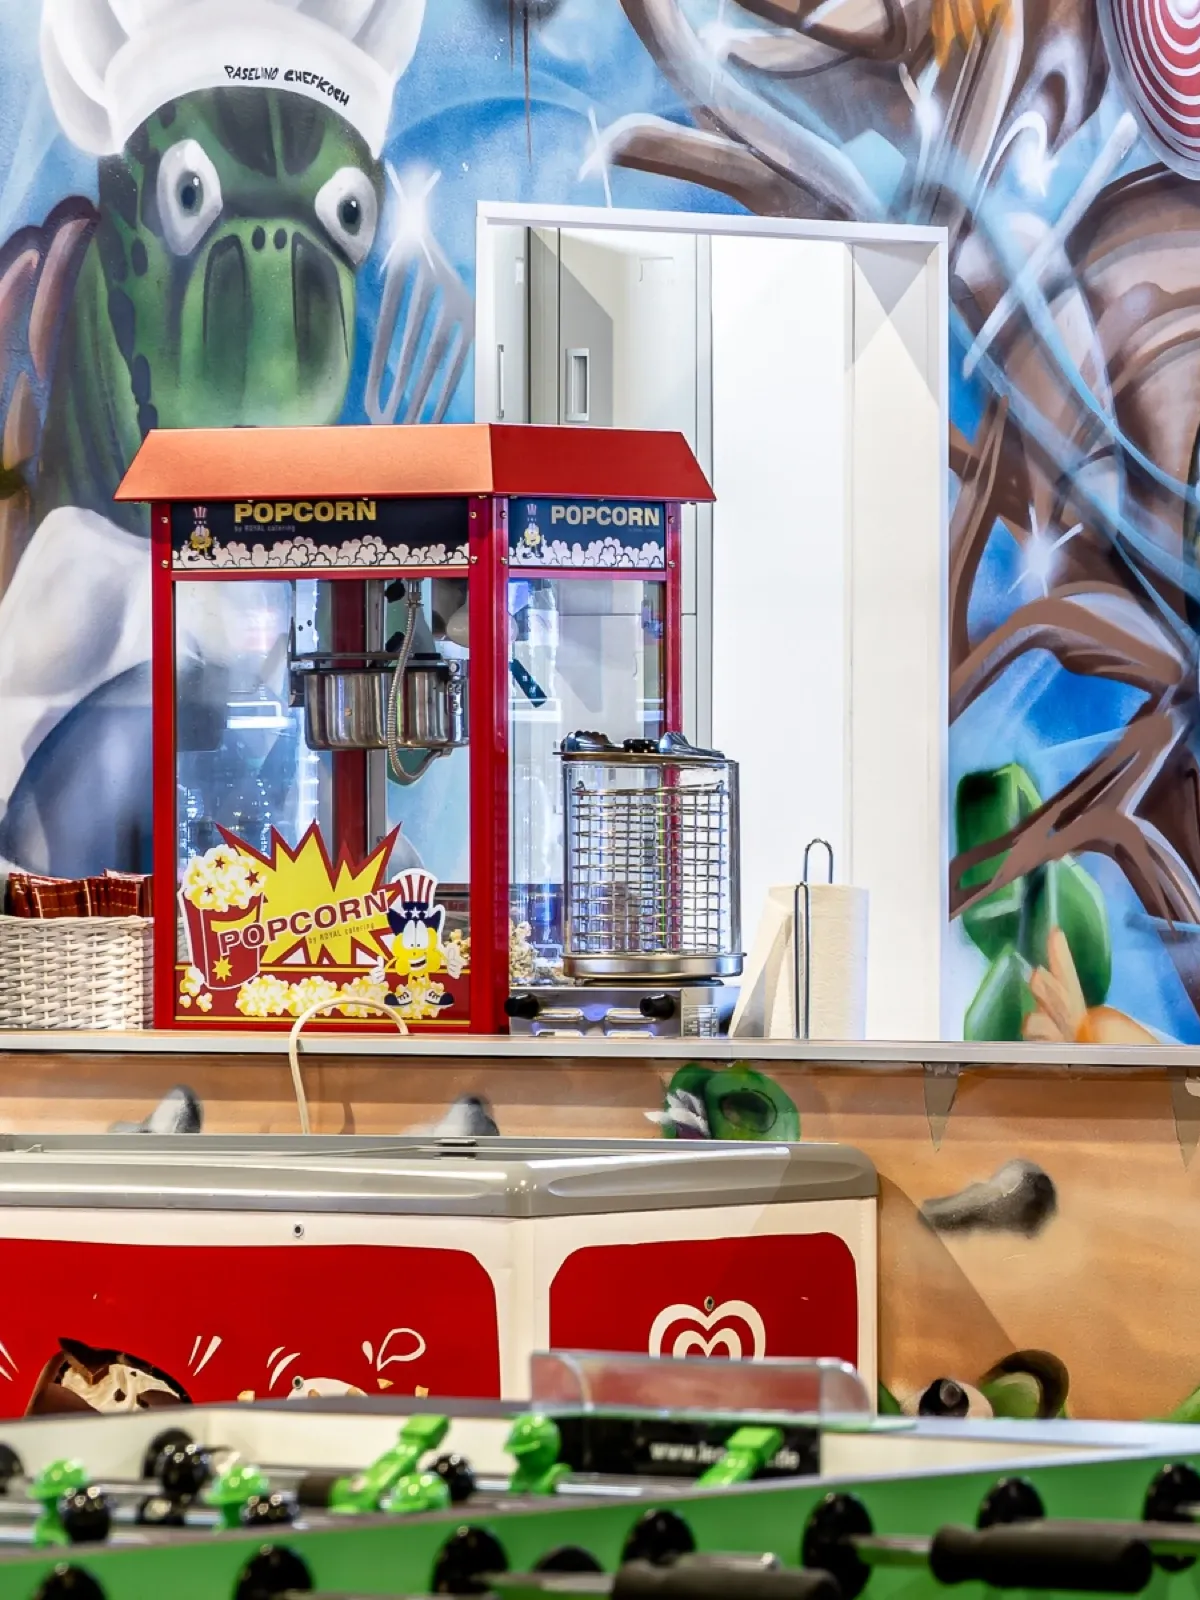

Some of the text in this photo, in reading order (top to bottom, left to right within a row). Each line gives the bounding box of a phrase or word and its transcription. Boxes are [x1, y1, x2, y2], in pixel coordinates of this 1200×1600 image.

[224, 65, 349, 106] PASELINO CHEFKOCH
[234, 501, 377, 523] POPCORN
[551, 505, 660, 526] POPCORN
[218, 889, 390, 955] POPCORN
[319, 930, 341, 944] ROYAL
[344, 922, 375, 937] catering
